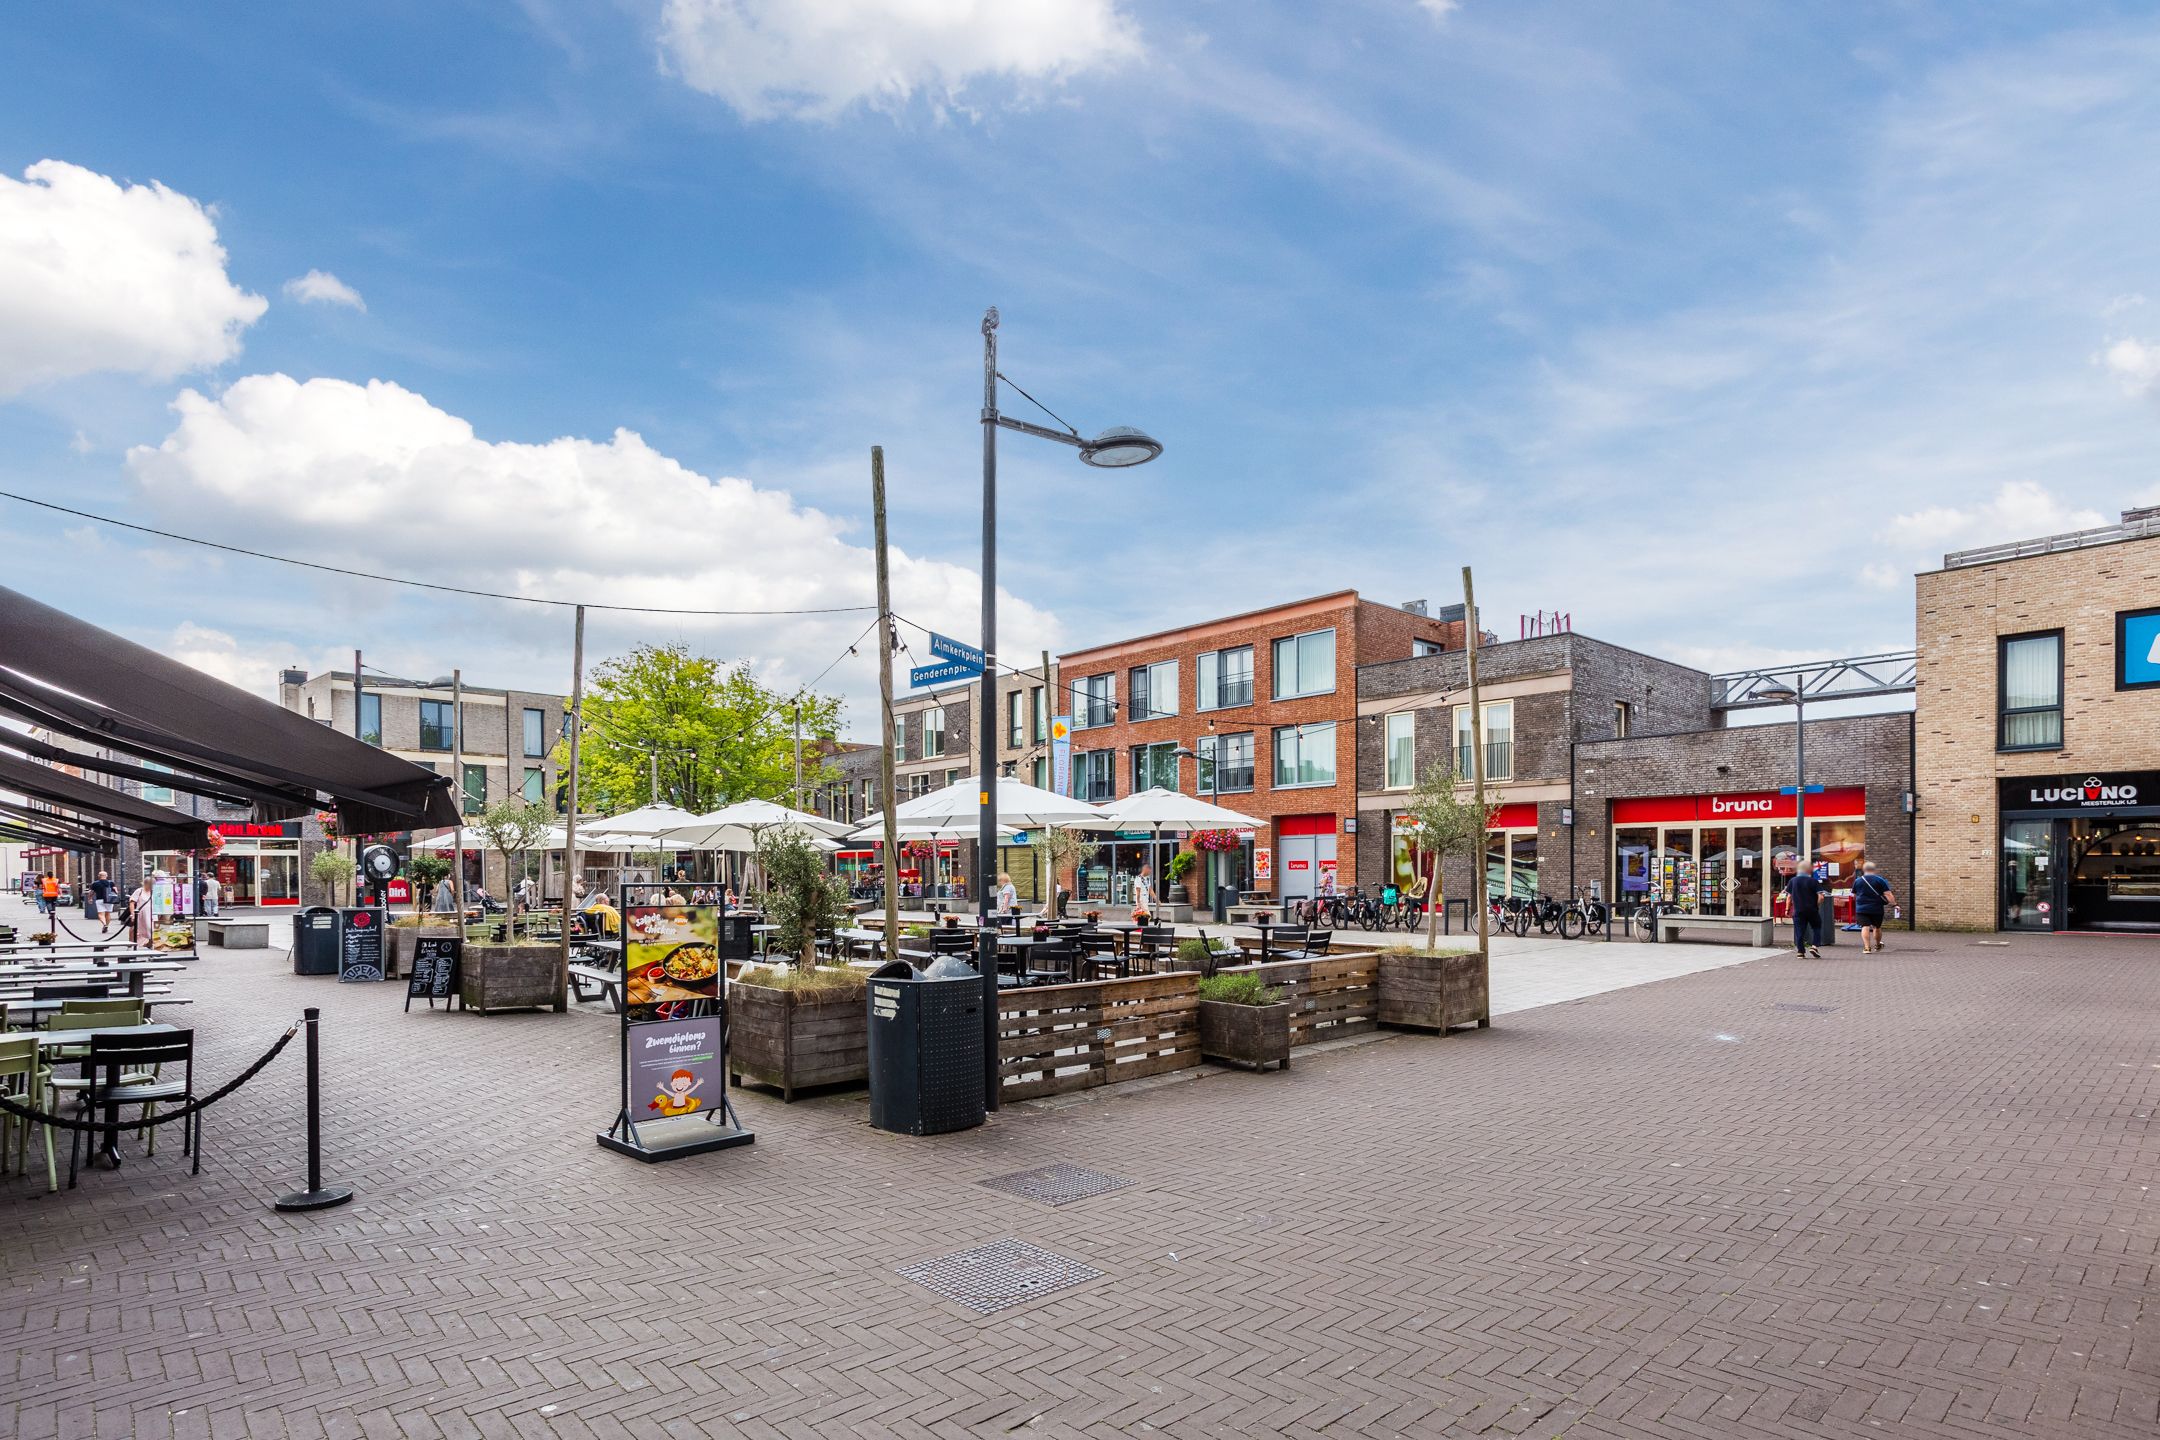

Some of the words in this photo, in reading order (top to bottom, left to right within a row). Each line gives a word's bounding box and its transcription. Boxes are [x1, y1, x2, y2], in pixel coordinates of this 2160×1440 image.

[934, 639, 983, 665] Almkerkplein
[913, 664, 971, 682] Genderenple
[2030, 784, 2137, 802] LUCIANO
[1712, 796, 1772, 813] bruna
[388, 887, 407, 897] Dirk
[645, 1031, 706, 1049] Zwemdiploma
[669, 1040, 702, 1054] binnen?
